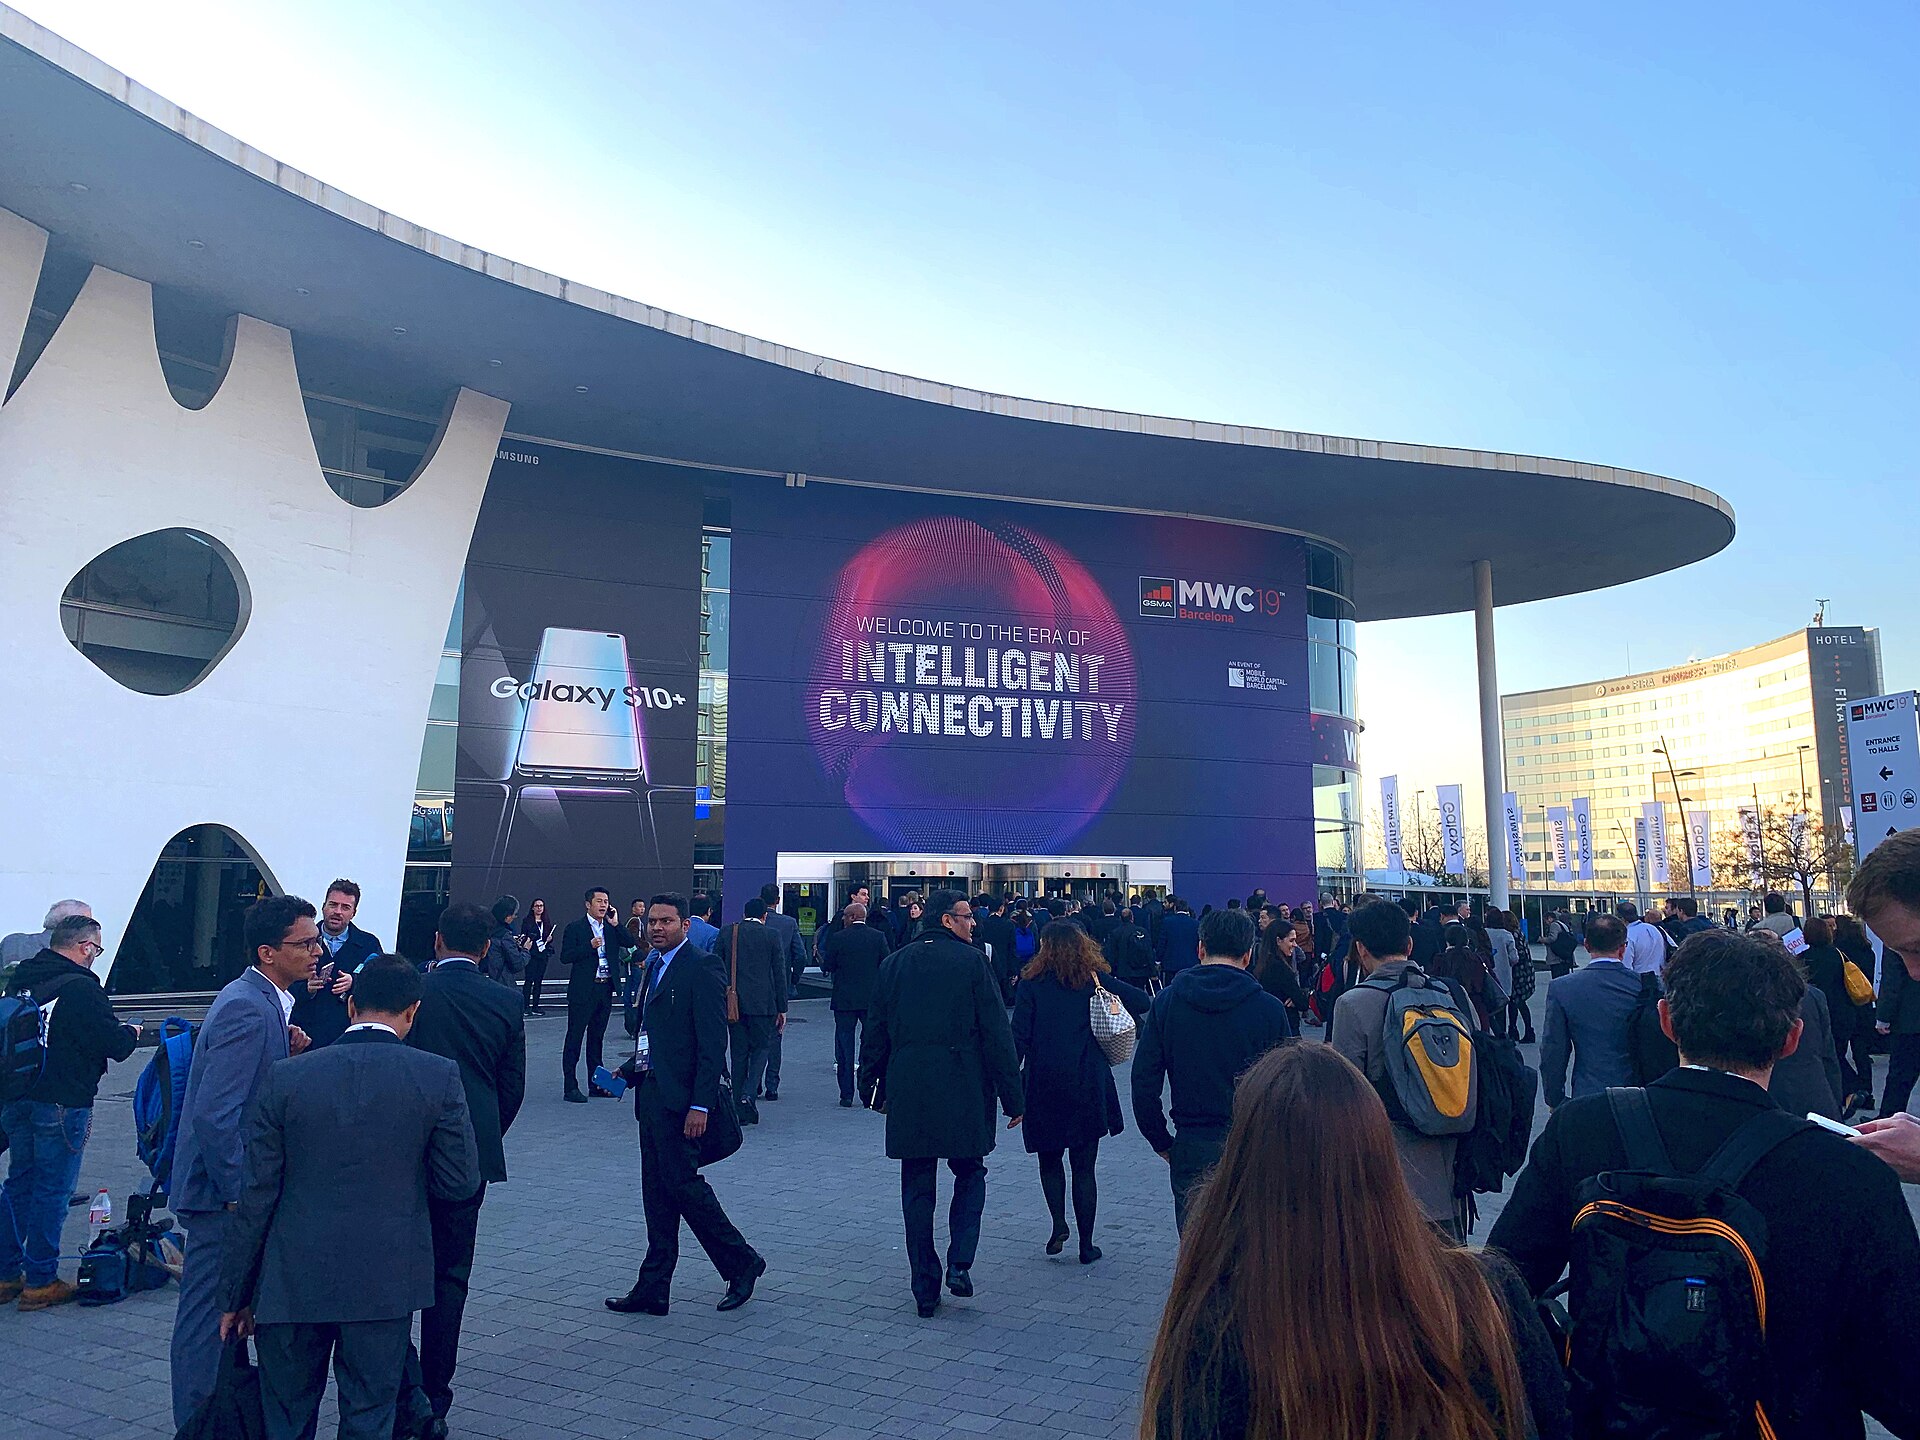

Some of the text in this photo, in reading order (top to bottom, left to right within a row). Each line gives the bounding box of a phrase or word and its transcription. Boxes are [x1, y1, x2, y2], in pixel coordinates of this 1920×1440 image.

[1142, 598, 1173, 609] GSMA
[1179, 608, 1234, 624] Barcelona
[856, 615, 1091, 646] WELCOME TO THE ERA OF
[1816, 635, 1857, 645] HOTEL
[842, 639, 1105, 693] INTELLIGENT
[1228, 660, 1237, 668] AN
[1237, 661, 1253, 669] EVENT
[1245, 669, 1266, 677] MOBILE
[1246, 676, 1266, 684] WORLD
[1246, 682, 1278, 691] BARCELONA
[489, 675, 687, 712] Galaxy S10+
[819, 687, 1125, 742] CONNECTIVITY
[1865, 735, 1901, 746] ENTRANCE
[1878, 744, 1900, 753] HALLS
[413, 806, 426, 815] 5G
[1638, 838, 1646, 860] SUD
